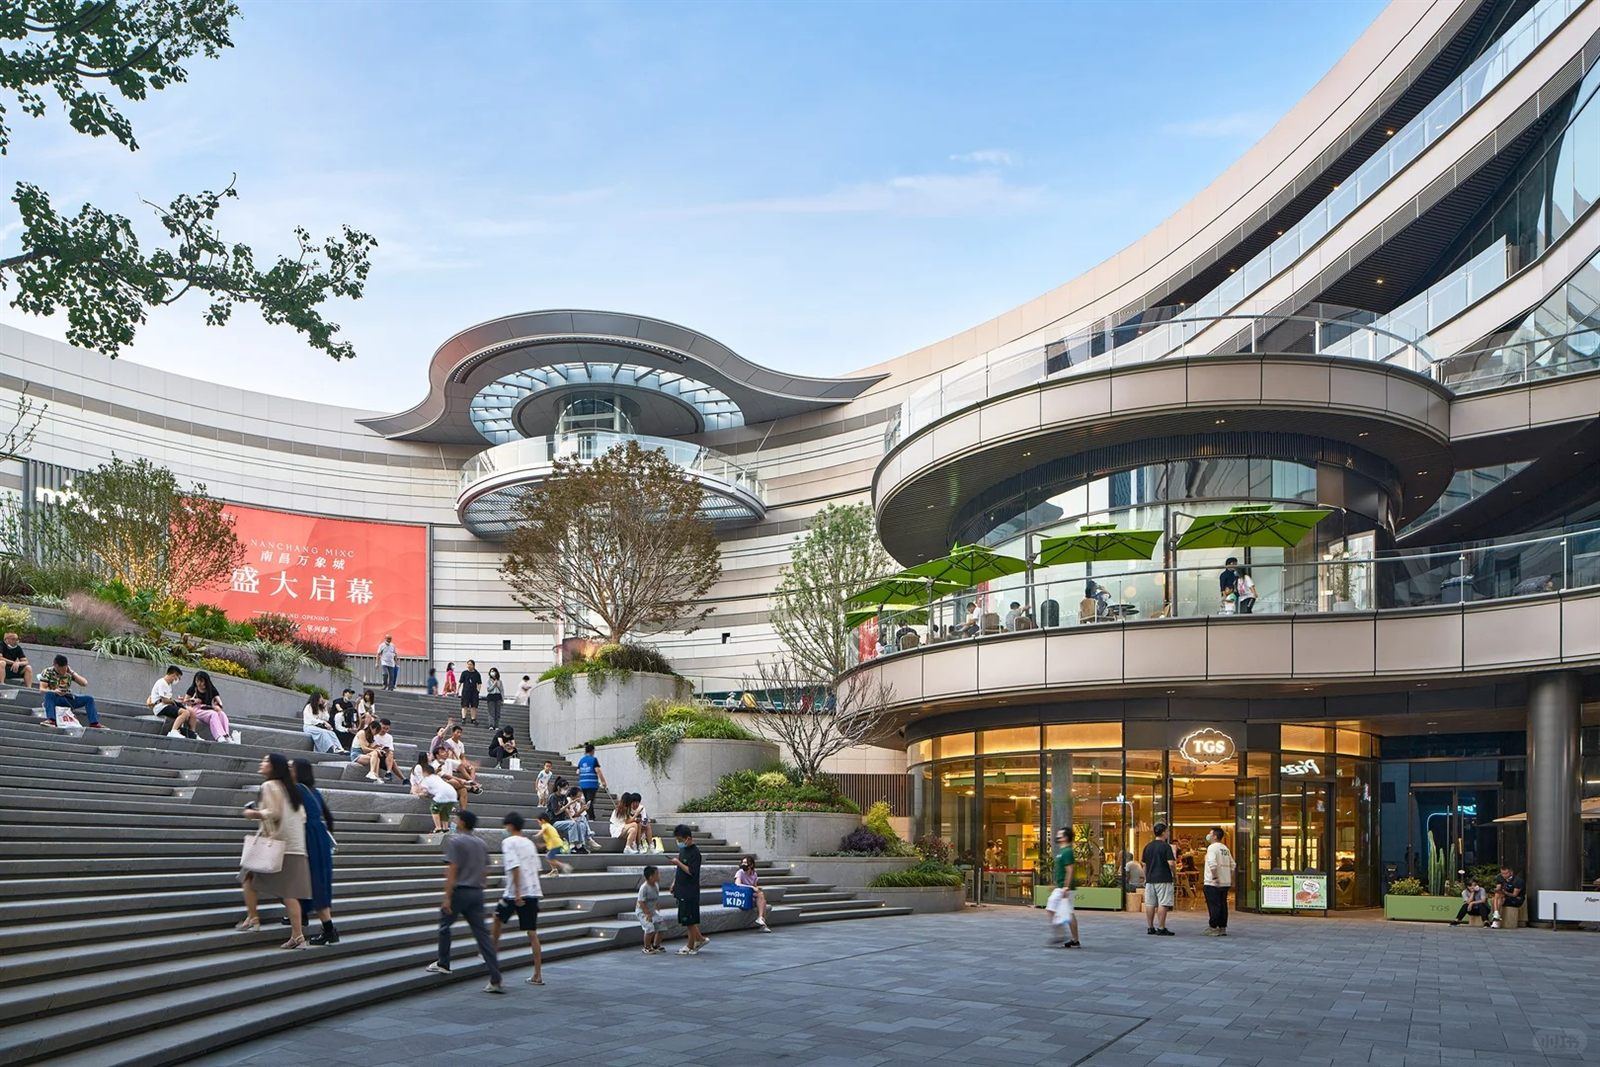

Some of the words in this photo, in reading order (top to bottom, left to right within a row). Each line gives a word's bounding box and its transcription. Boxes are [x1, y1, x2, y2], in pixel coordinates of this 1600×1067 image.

[250, 539, 318, 555] NANCHANG
[325, 548, 354, 558] MIXC
[260, 550, 345, 570] 南昌万象城
[231, 566, 374, 605] 盛大启幕
[1193, 740, 1225, 754] TGS
[726, 898, 745, 907] KID!
[1429, 904, 1450, 912] TGS
